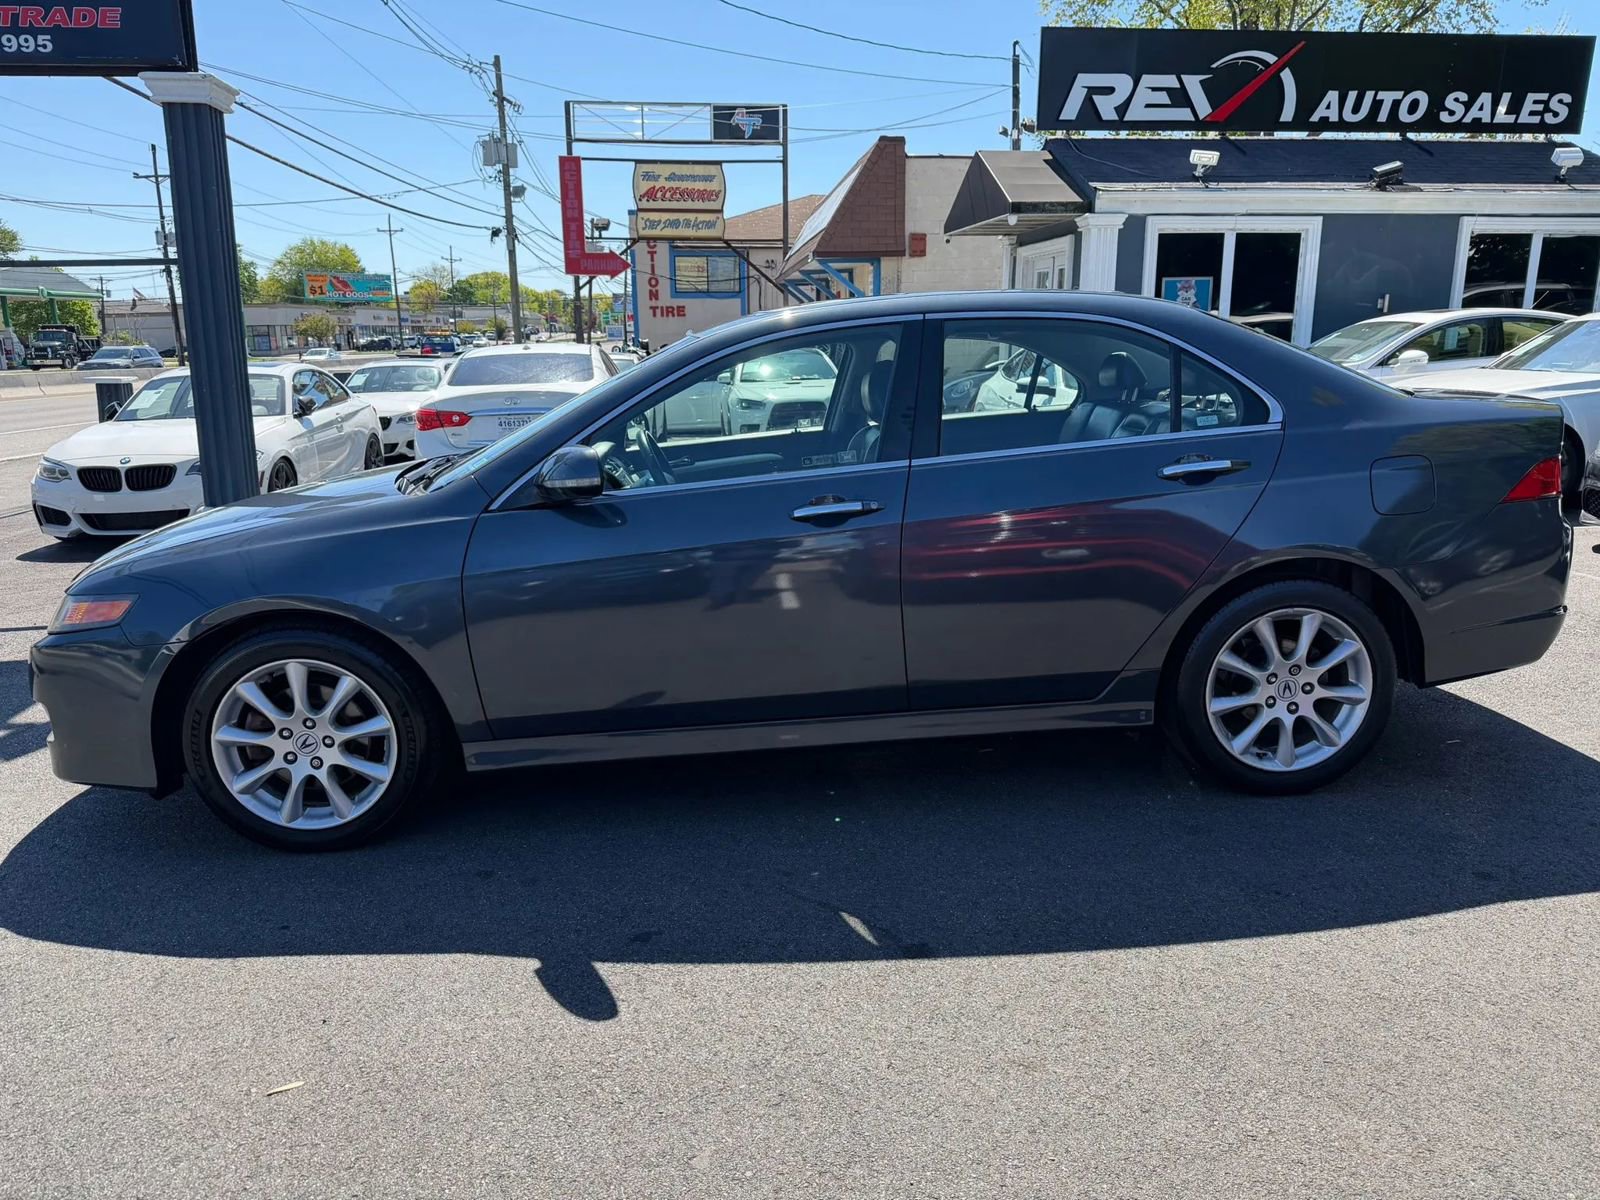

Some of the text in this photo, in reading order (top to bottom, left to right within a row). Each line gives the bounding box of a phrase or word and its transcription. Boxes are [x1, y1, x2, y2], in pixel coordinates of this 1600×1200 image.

[0, 6, 121, 28] TRADE
[1309, 90, 1429, 123] AUTO
[1439, 91, 1572, 124] SALES
[639, 185, 721, 203] ACCESSORIES
[646, 240, 659, 300] CTION
[309, 284, 326, 296] $1
[649, 305, 686, 318] TIRE
